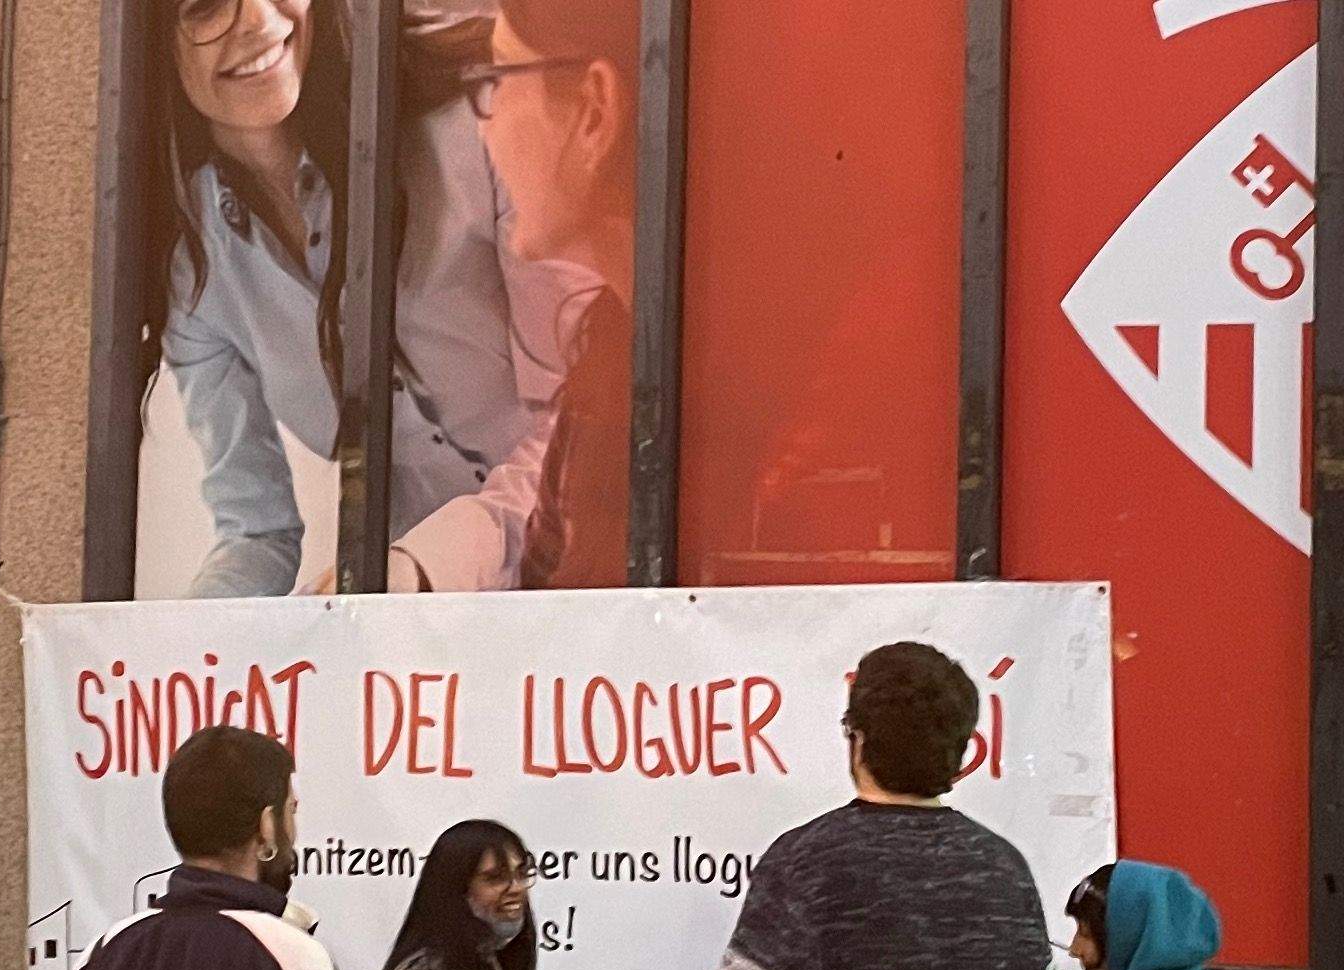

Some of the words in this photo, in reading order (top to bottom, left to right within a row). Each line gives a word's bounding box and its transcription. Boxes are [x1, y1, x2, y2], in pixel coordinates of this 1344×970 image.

[364, 671, 473, 778] DEL
[522, 674, 788, 779] LLOGUER
[591, 851, 660, 883] uns
